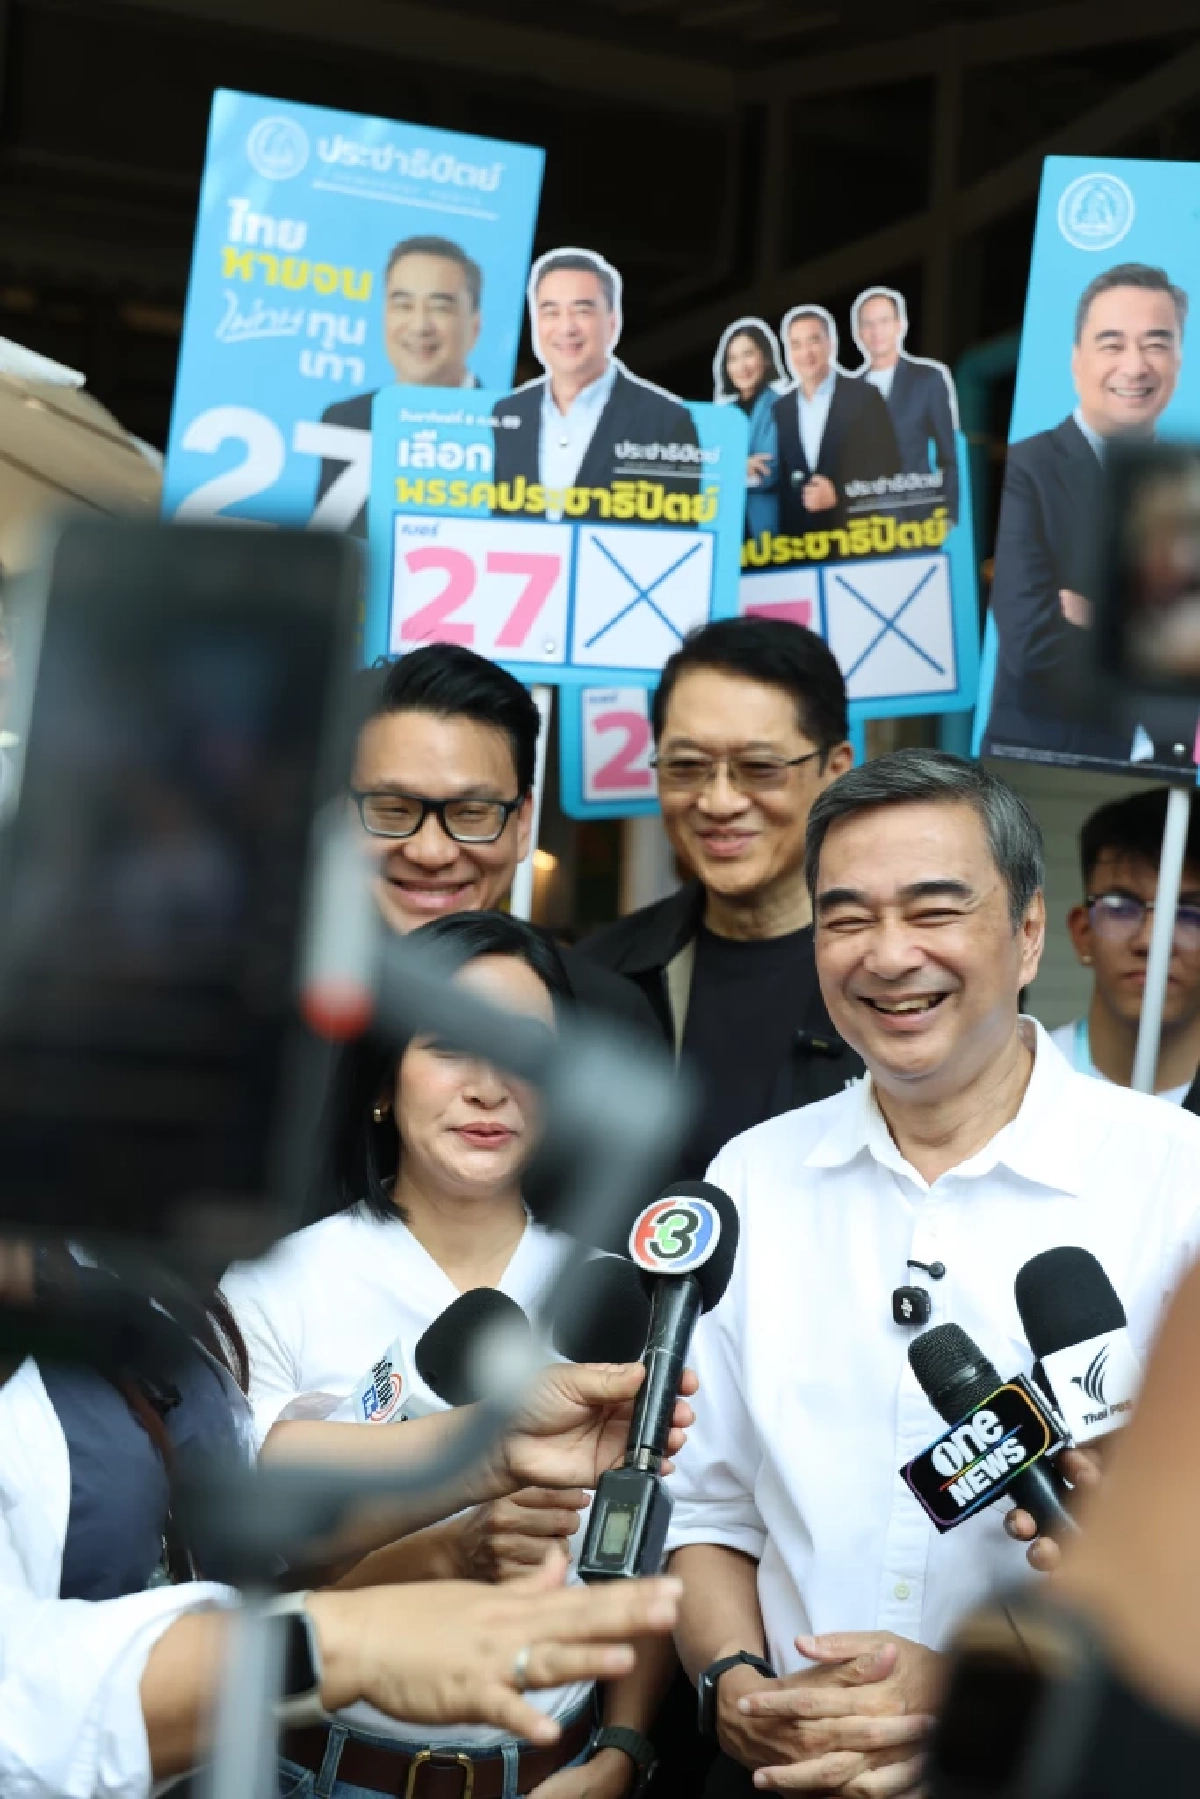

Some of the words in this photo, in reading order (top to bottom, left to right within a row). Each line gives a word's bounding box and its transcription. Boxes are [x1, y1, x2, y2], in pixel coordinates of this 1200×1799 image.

[228, 197, 308, 252] ไทย
[221, 246, 373, 302] หายจน
[306, 309, 367, 351] ทุน
[299, 349, 366, 388] เทา
[171, 405, 372, 531] 27
[397, 429, 493, 473] เลือก
[395, 474, 721, 524] พรรคประชาธิปัตย์
[741, 506, 951, 568] ประชาธิปัตย์
[400, 546, 562, 648] 27
[931, 1410, 1004, 1477] one
[1081, 1407, 1108, 1426] Thai
[948, 1437, 1027, 1507] NEWS
